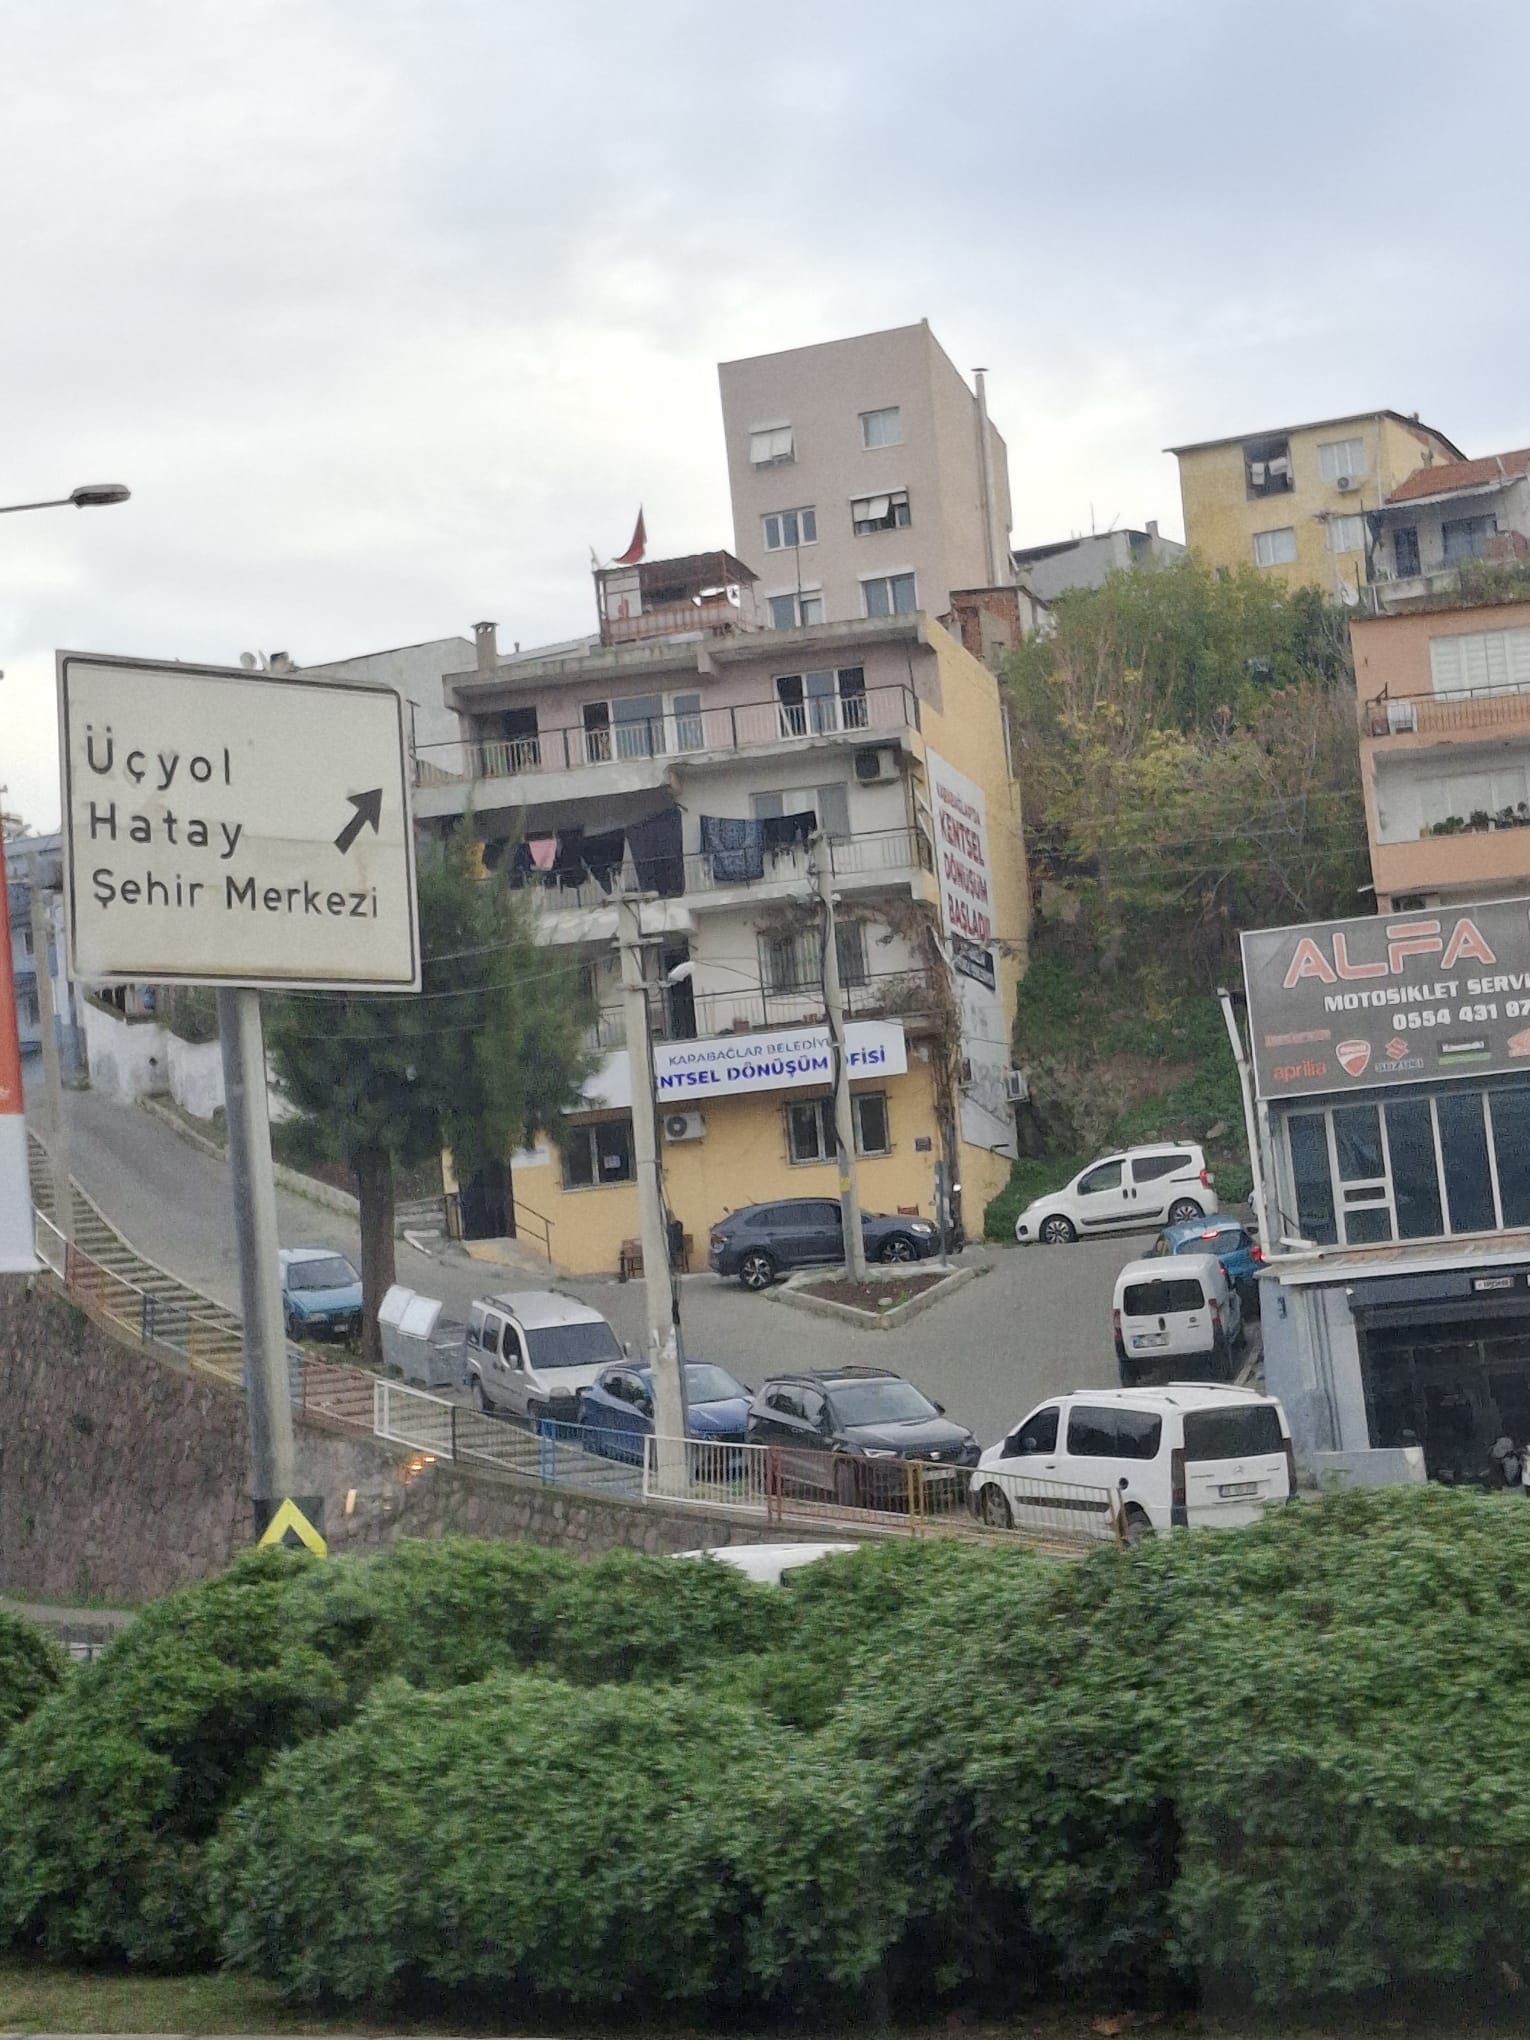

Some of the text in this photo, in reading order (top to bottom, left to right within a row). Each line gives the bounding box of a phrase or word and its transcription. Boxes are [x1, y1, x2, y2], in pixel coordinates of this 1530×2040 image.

[86, 725, 231, 790] Üçyol
[90, 801, 243, 859] Hatay
[93, 868, 378, 918] Şehir Merkezi
[1283, 918, 1497, 989] ALFA
[1392, 1009, 1451, 1031] 0554
[1458, 1003, 1498, 1022] 431
[727, 1055, 828, 1081] DÖNÜŞÜM
